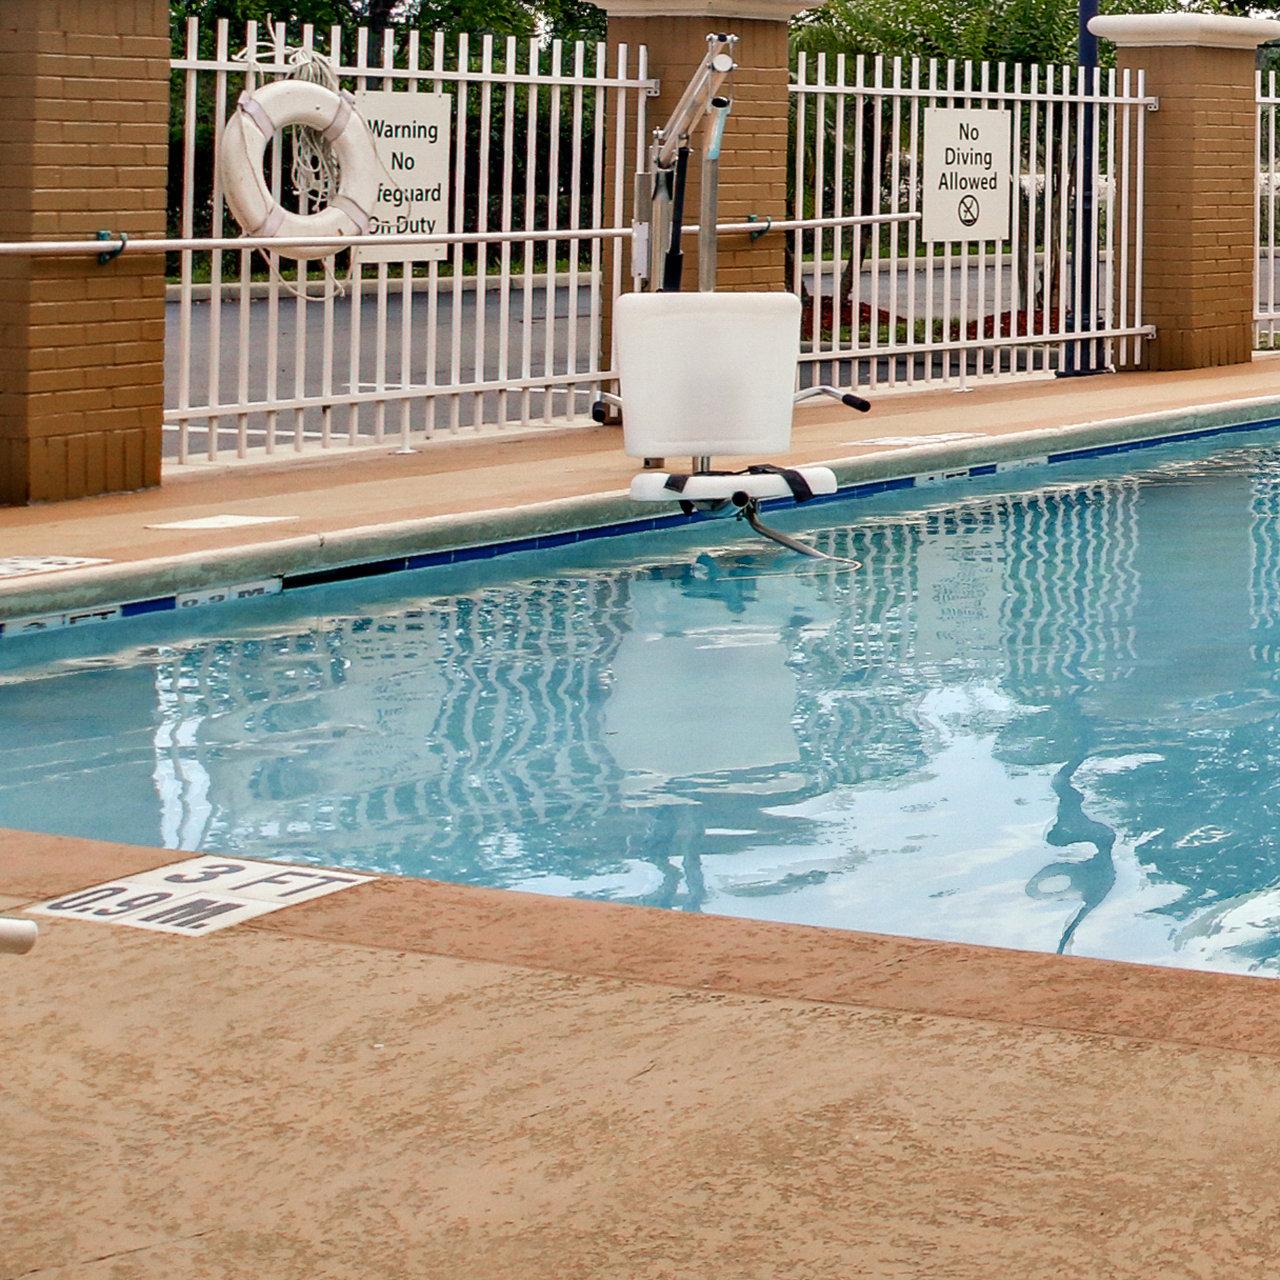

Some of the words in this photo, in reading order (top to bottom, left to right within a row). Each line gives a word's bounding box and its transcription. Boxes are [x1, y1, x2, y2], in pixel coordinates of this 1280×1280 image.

[367, 119, 439, 144] Warning
[958, 123, 979, 141] No
[391, 151, 415, 171] No
[944, 147, 993, 170] Diving
[938, 172, 998, 190] Allowed
[377, 182, 442, 207] feguard
[396, 214, 437, 235] Duty
[163, 863, 247, 884] 3
[227, 870, 358, 898] FT
[45, 886, 174, 916] 0.9
